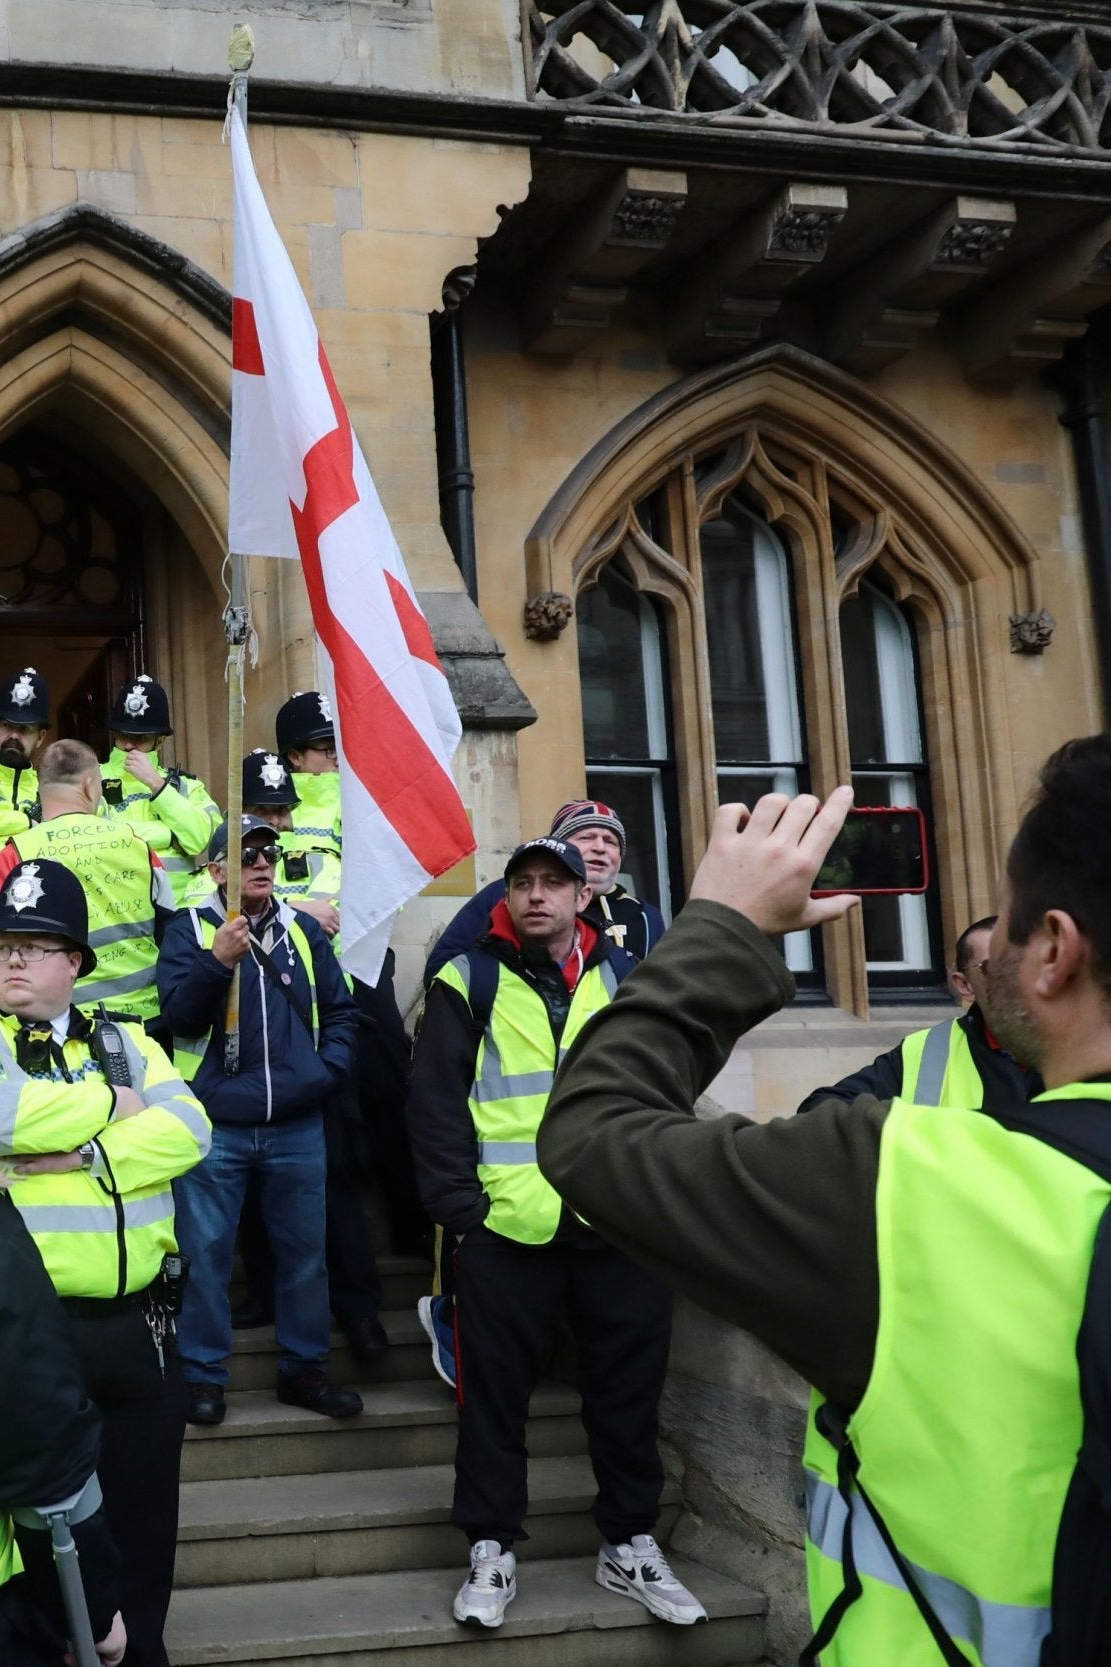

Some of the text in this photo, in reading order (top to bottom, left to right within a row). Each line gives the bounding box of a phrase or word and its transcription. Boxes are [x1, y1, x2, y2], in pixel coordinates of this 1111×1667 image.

[46, 825, 116, 842] FORCED
[36, 838, 133, 858] ADOPTION
[75, 856, 103, 868] AND
[104, 870, 138, 884] CARE
